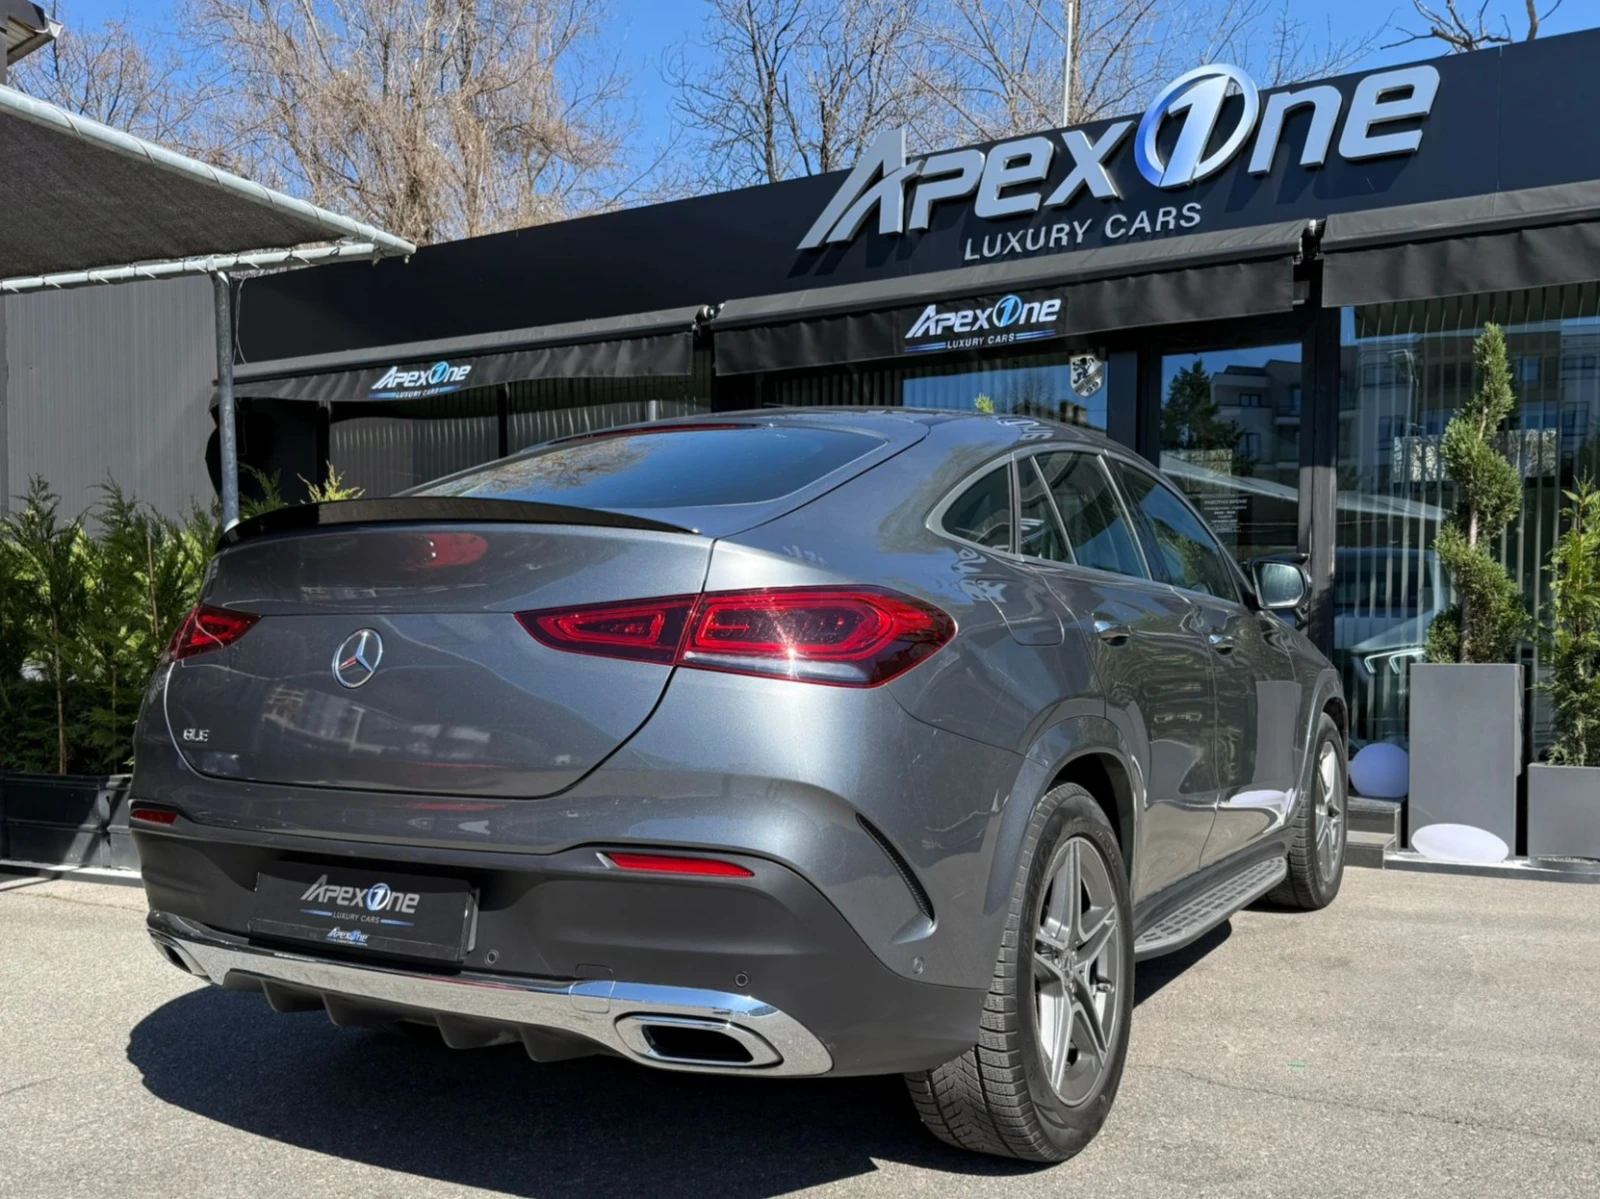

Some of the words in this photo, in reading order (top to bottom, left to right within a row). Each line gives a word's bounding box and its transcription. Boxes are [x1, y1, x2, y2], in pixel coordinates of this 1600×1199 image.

[963, 219, 1092, 262] LUXURY
[1104, 202, 1203, 239] CARS
[947, 337, 984, 349] LUXURY
[988, 333, 1015, 344] CARS
[396, 390, 422, 398] LUXURY
[423, 388, 440, 396] CARS
[183, 728, 210, 742] GLE
[332, 911, 359, 921] LUXURY
[360, 914, 381, 924] CARS
